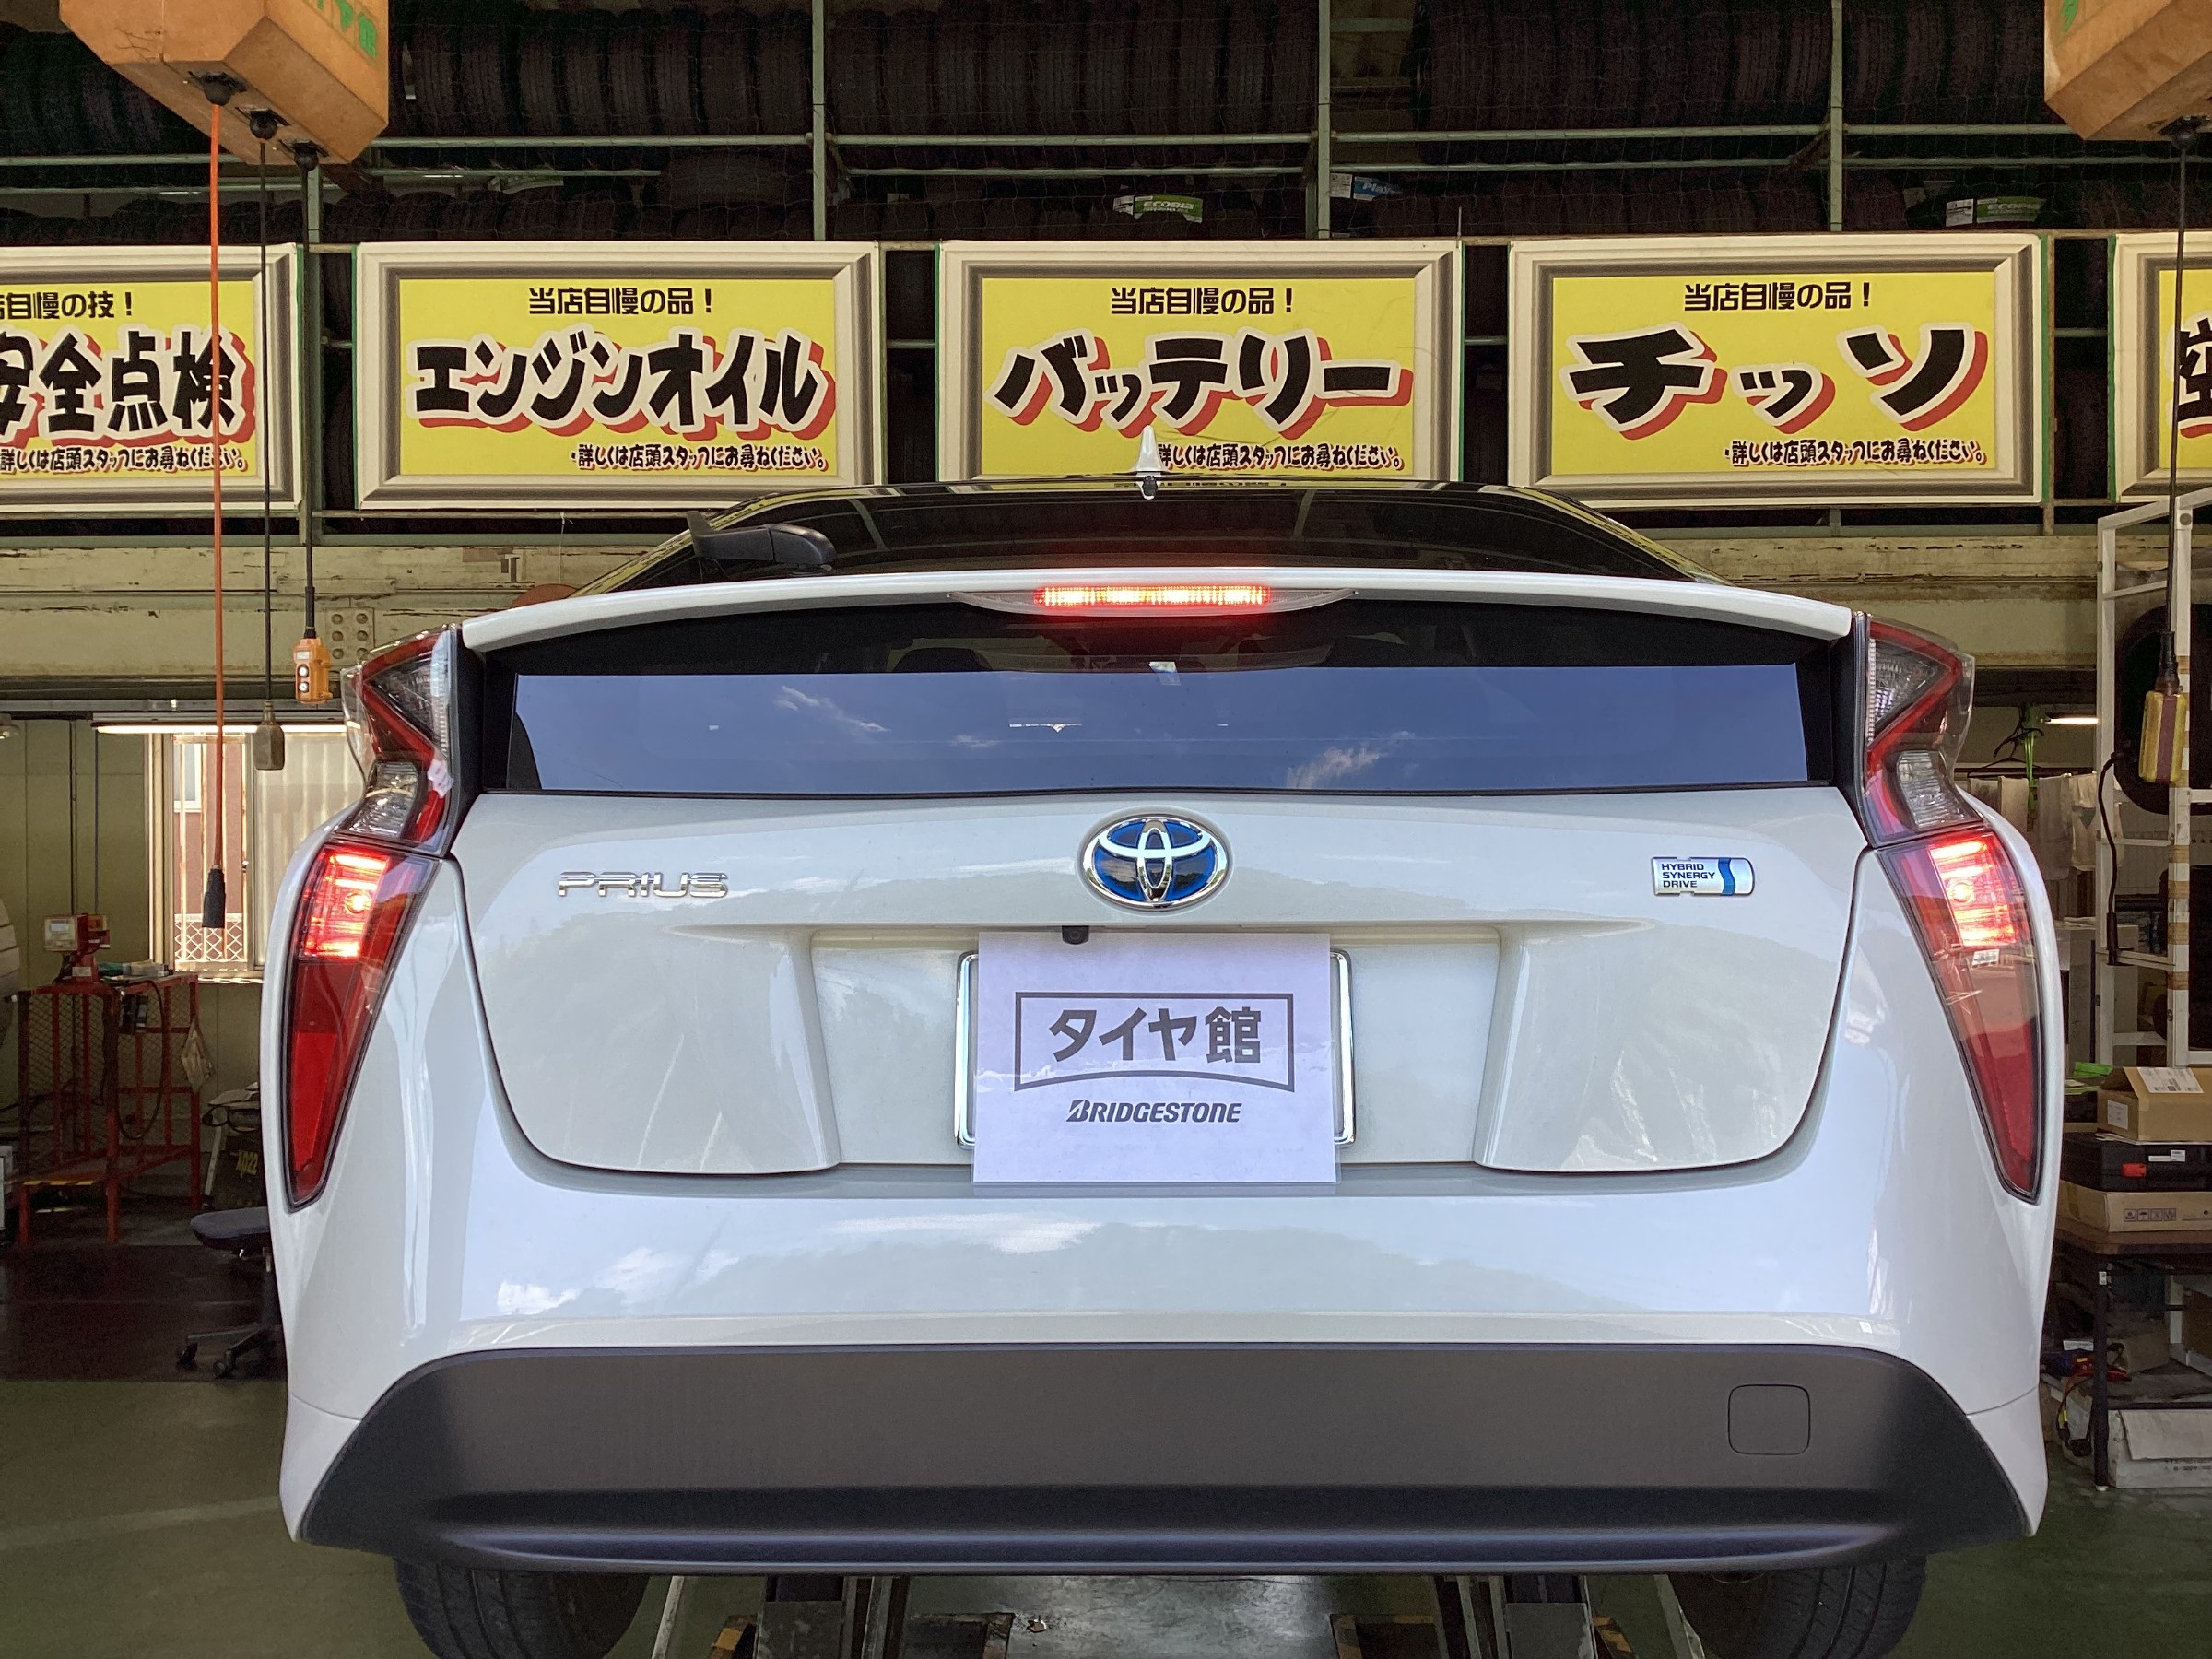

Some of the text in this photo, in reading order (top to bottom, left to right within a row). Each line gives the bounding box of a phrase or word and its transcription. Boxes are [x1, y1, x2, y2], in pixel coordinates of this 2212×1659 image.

[0, 290, 133, 320] 自慢の技!
[528, 288, 713, 315] 当店自慢の品!
[1111, 287, 1293, 315] 当店自慢の品!
[1684, 281, 1871, 312] 当店自慢の品!
[415, 329, 818, 427] エンジンオイル
[993, 332, 1393, 426] バッテリー
[1569, 327, 1965, 425] チッソ
[1661, 863, 1704, 871] HYBRID
[1662, 871, 1715, 879] SYNERGY
[558, 871, 729, 898] PRIUS
[1048, 1006, 1262, 1064] タイヤ館
[1065, 1100, 1242, 1123] BRIDGESTONE
